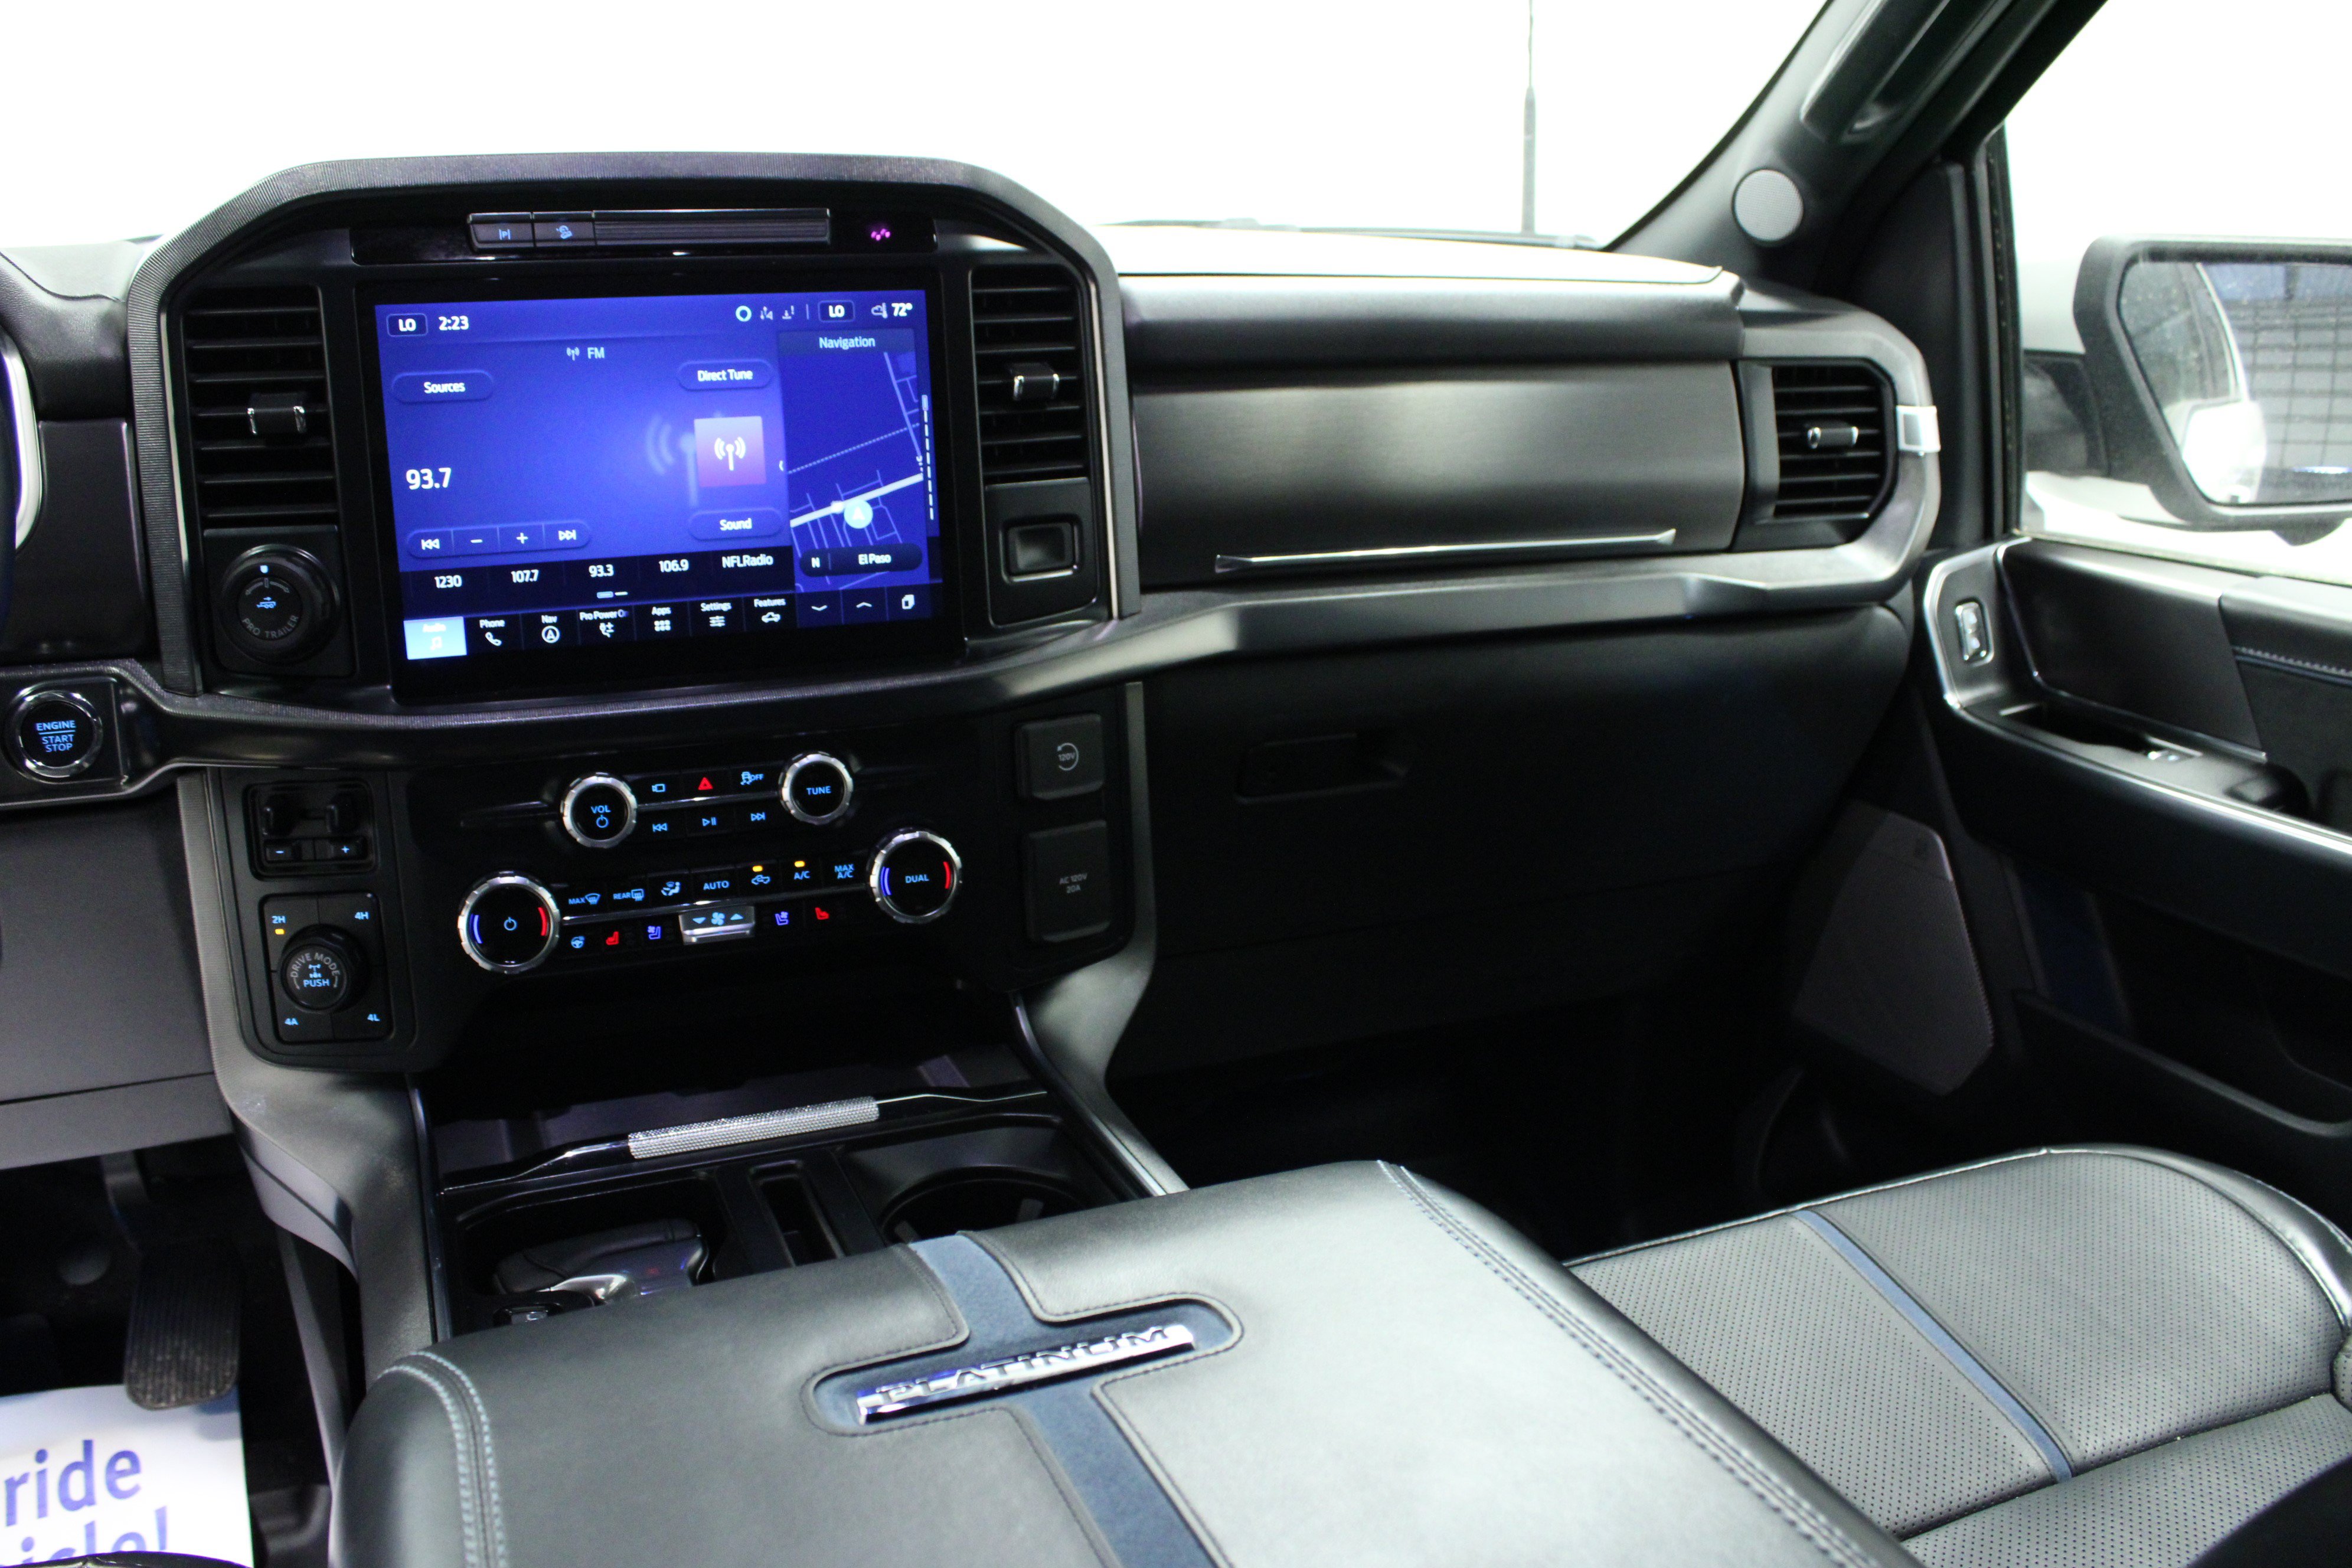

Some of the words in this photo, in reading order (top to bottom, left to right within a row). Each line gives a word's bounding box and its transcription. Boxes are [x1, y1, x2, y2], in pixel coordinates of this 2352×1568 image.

[828, 305, 845, 318] LO
[398, 318, 416, 332] LO
[438, 315, 469, 331] 2:23
[819, 335, 876, 351] Navigation
[587, 347, 605, 359] FM
[697, 369, 727, 382] Direct
[727, 368, 753, 381] Tune
[423, 381, 466, 394] Sources
[406, 467, 452, 490] 93.7
[719, 517, 753, 531] Sound
[659, 559, 689, 573] 106.9
[811, 557, 821, 568] N
[589, 564, 615, 577] 93.3
[511, 569, 540, 583] 107.7
[434, 574, 462, 589] 1230
[700, 602, 733, 612] Settings
[753, 598, 786, 608] Features
[593, 610, 618, 620] Power
[651, 606, 672, 616] Apps
[479, 619, 505, 629] Phone
[541, 615, 558, 624] Nav
[241, 618, 261, 636] PRO
[265, 615, 299, 639] TRAILER
[36, 720, 76, 731] ENGINE
[42, 734, 74, 744] START
[45, 743, 73, 753] STOP
[750, 773, 764, 782] OFF
[806, 786, 831, 795] TUNE
[591, 805, 611, 815] VOL
[834, 864, 854, 873] MAX
[793, 870, 811, 880] A/C
[837, 870, 854, 880] A/C
[905, 874, 930, 884] DUAL
[703, 880, 730, 891] AUTO
[569, 896, 585, 905] MAX
[613, 891, 631, 900] REAR
[272, 915, 286, 924] 2H
[354, 911, 370, 920] 4H
[290, 952, 312, 978] DRIVE
[313, 952, 341, 976] MODE
[303, 979, 330, 988] PUSH
[285, 1017, 299, 1026] 4A
[367, 1014, 380, 1023] 4L
[872, 1326, 1175, 1405] PLATINUM
